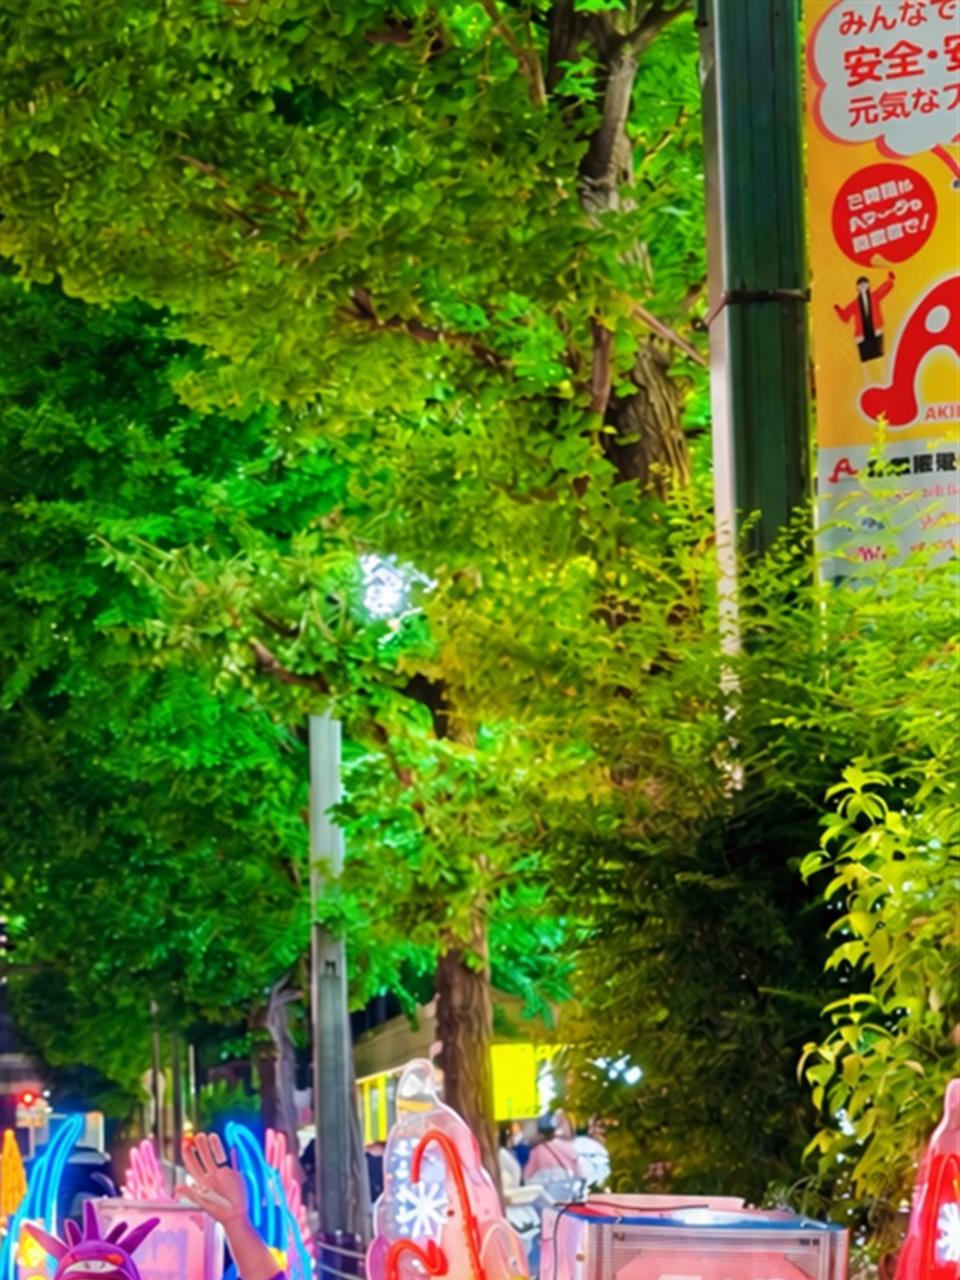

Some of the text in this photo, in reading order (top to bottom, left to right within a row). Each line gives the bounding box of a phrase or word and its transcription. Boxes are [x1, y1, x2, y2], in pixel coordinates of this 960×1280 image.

[839, 0, 957, 35] みんなで
[925, 403, 960, 421] AKI
